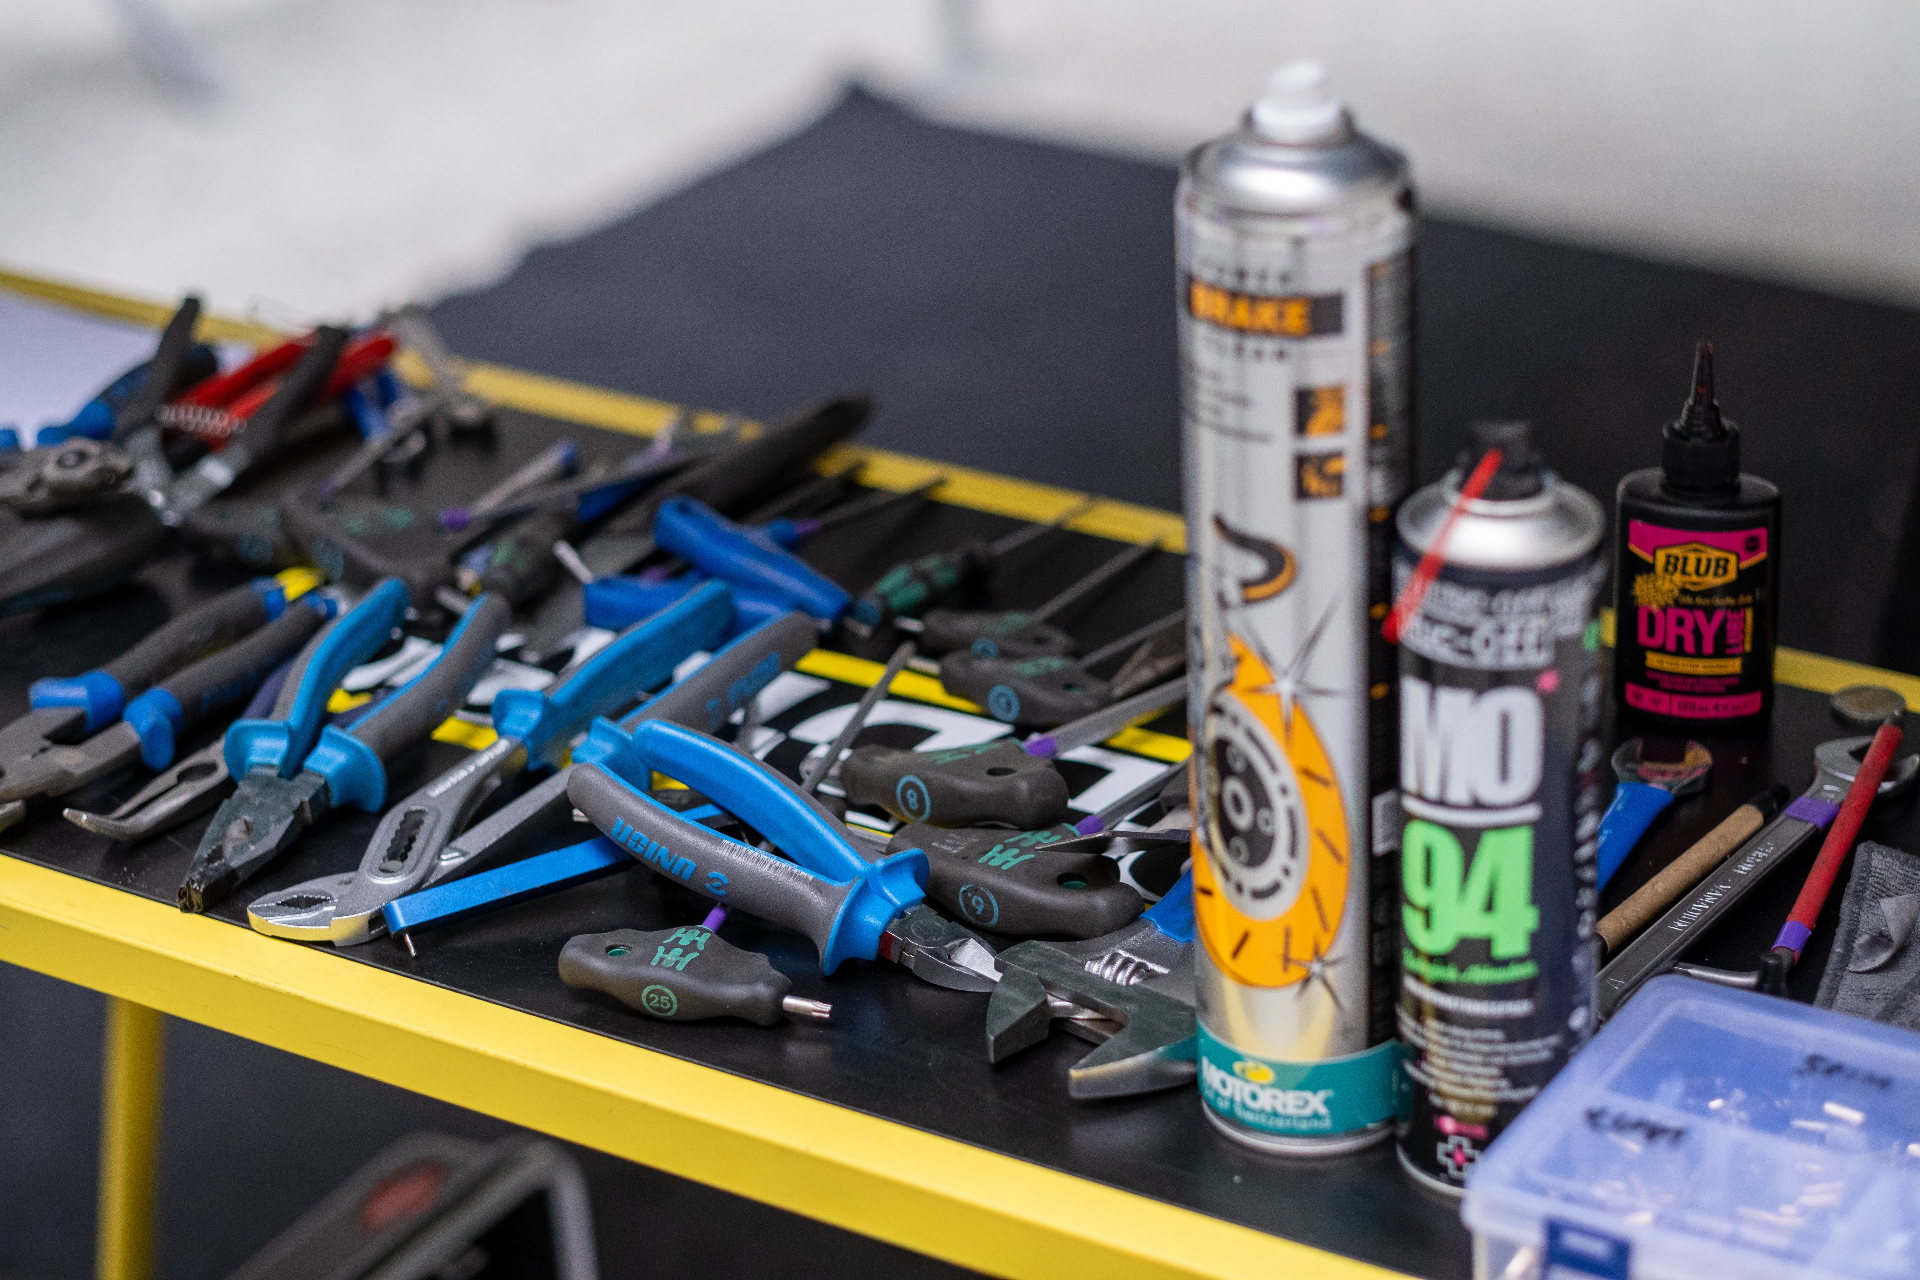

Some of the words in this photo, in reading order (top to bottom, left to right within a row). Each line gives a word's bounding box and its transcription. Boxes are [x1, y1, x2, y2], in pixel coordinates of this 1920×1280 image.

[1663, 553, 1730, 578] BLUB
[1637, 604, 1726, 656] DRY
[1401, 674, 1545, 808] MO
[906, 788, 918, 810] 8
[1401, 818, 1541, 960] 94
[649, 993, 671, 1010] 25
[1201, 1055, 1334, 1117] MOTOREX
[1233, 1099, 1332, 1131] Switzerland
